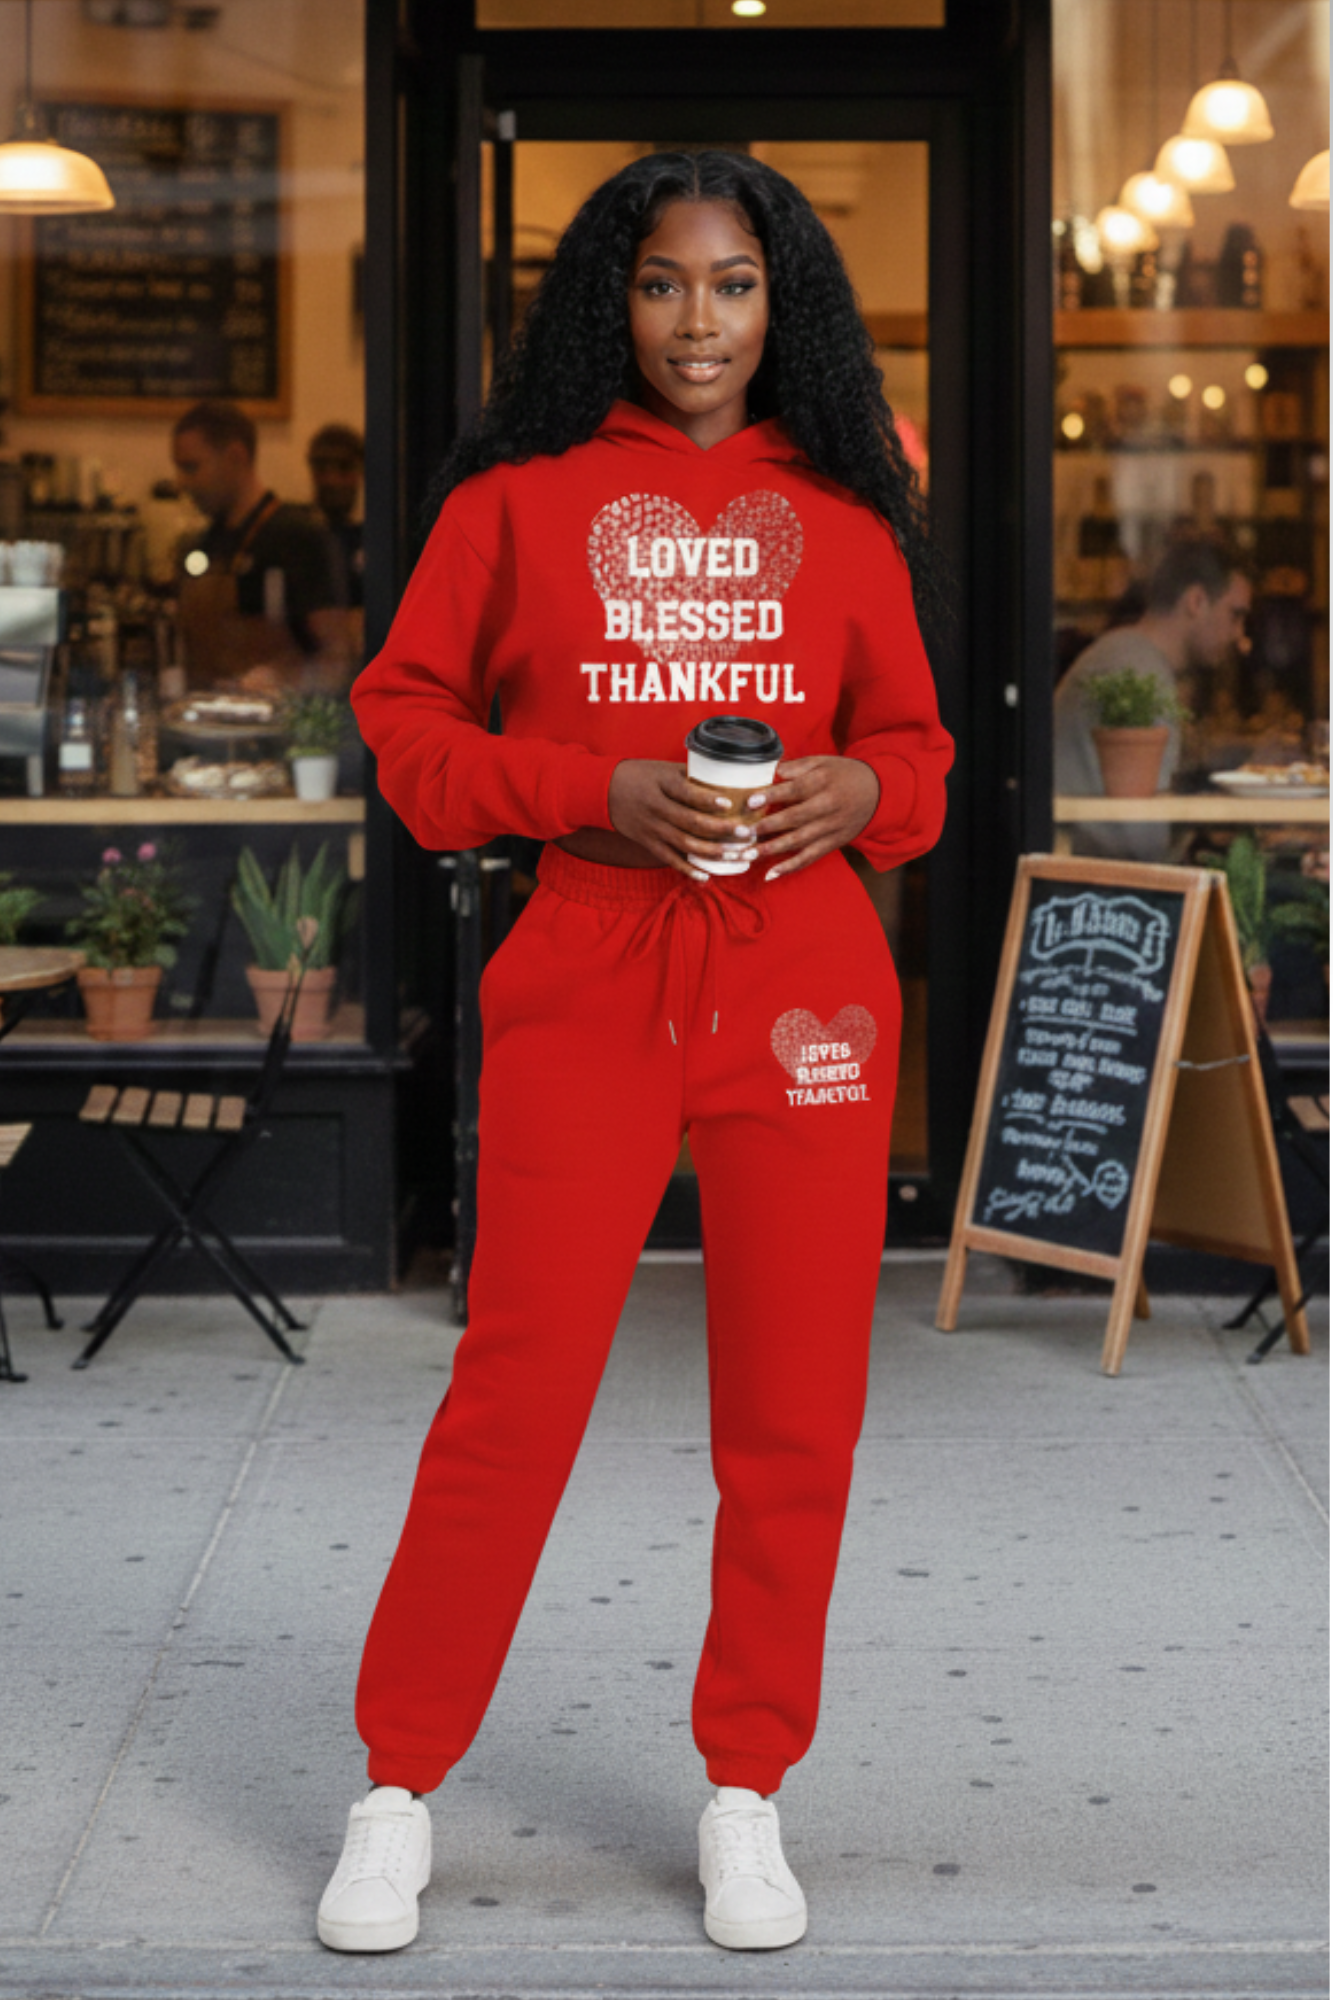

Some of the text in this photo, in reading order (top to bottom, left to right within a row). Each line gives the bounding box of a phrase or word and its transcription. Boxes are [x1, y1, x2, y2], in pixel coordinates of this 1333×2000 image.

[627, 536, 760, 578] LOVED
[604, 600, 784, 641] BLESSED
[580, 662, 806, 703] THANKFUL
